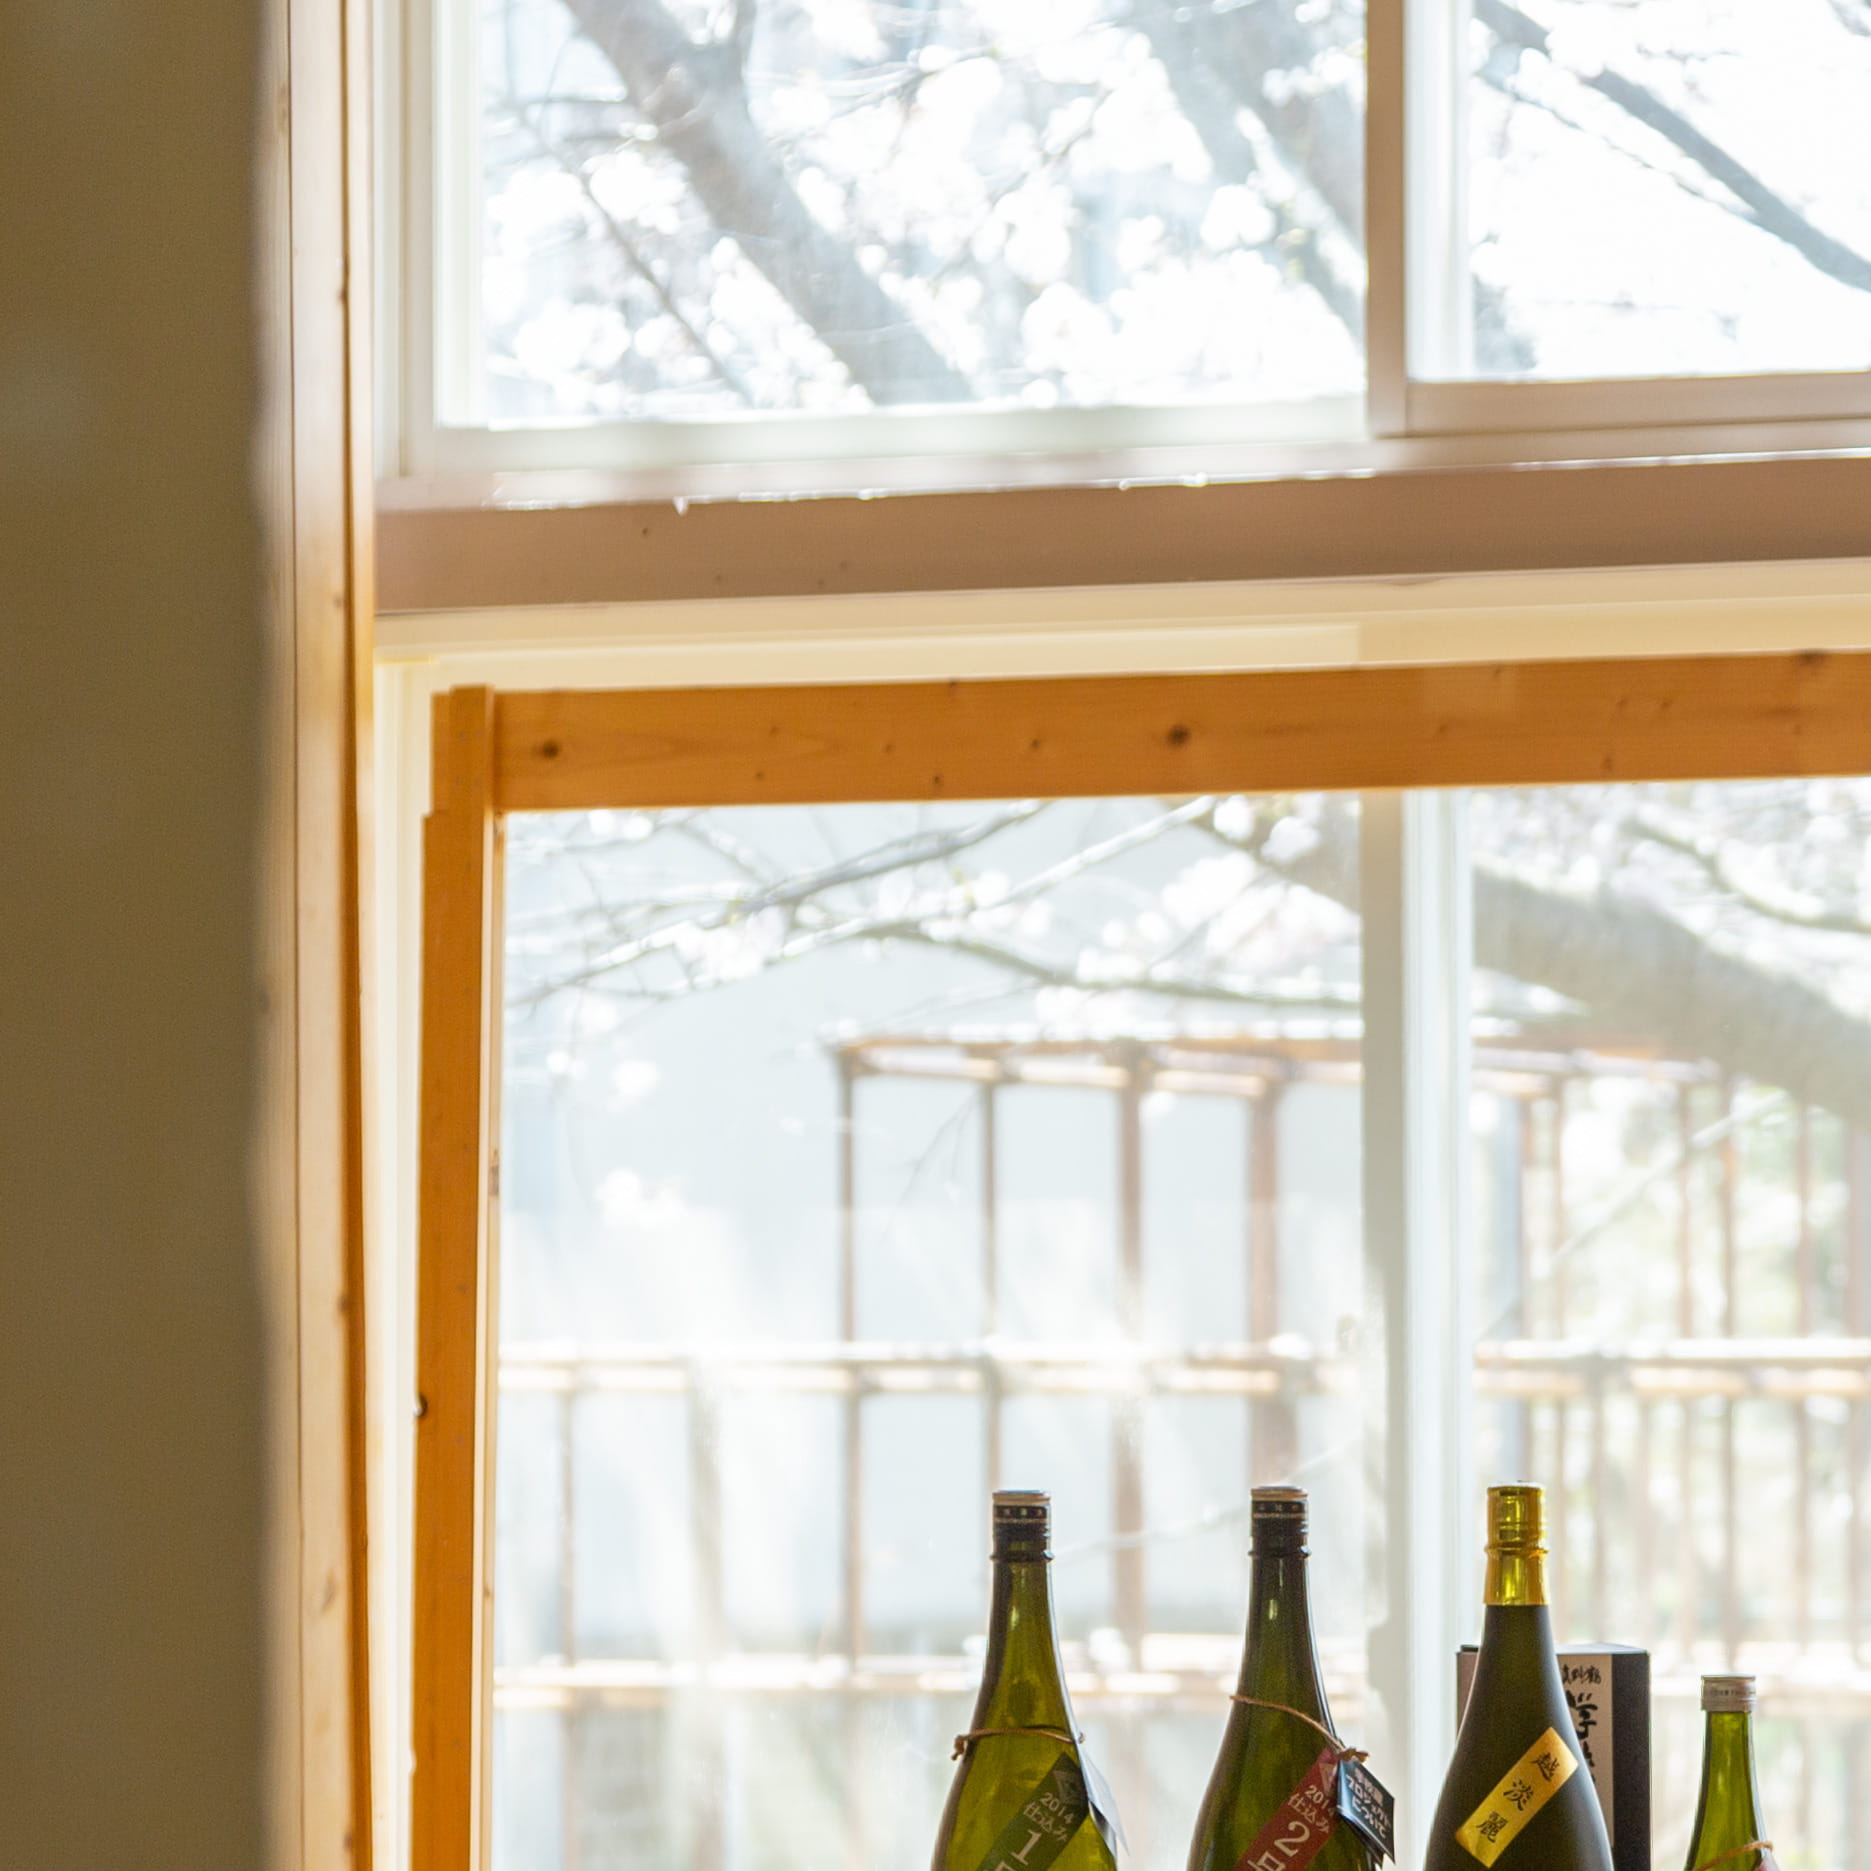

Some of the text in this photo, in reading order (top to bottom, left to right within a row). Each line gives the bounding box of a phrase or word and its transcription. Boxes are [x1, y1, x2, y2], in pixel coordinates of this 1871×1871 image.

[1040, 1791, 1075, 1825] 2014
[1287, 1792, 1330, 1835] 仕込み
[1475, 1752, 1561, 1844] 越淡麗
[1022, 1801, 1069, 1842] 仕込み
